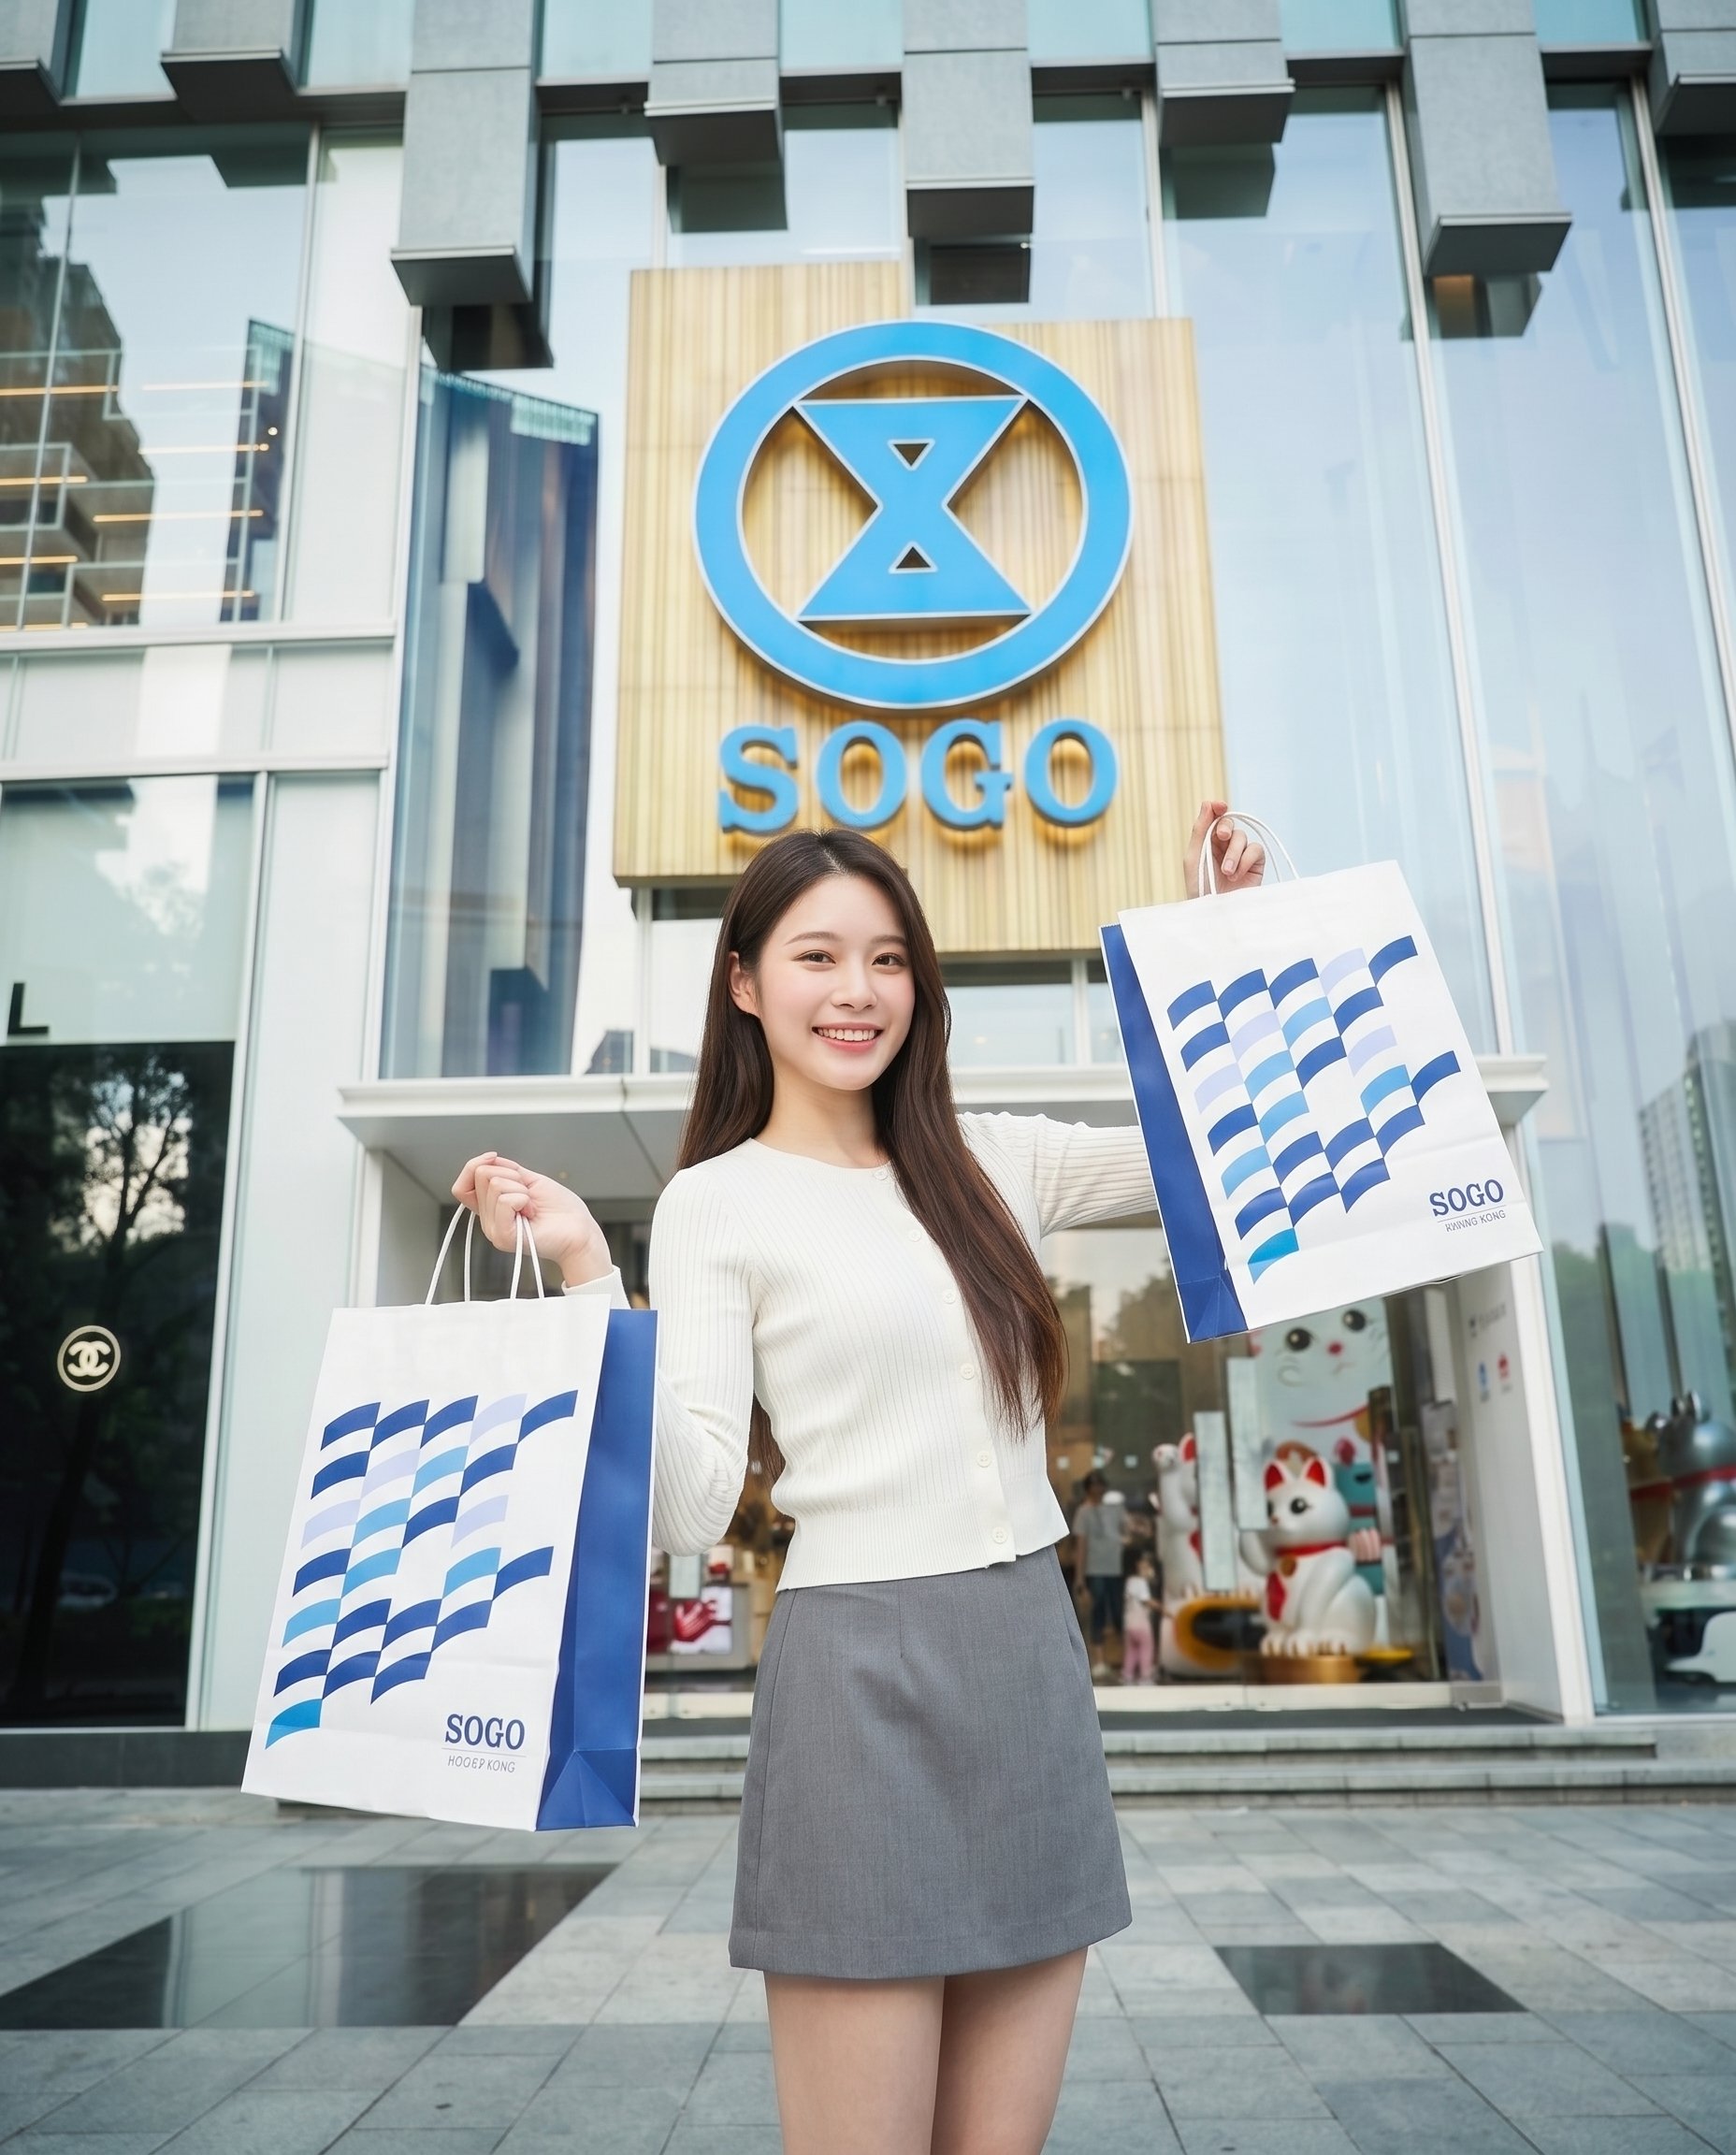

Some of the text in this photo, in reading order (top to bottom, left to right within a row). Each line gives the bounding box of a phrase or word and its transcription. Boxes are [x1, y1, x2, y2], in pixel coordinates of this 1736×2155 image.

[717, 717, 1120, 833] SOGO
[7, 982, 50, 1034] L
[1429, 1179, 1504, 1217] SOGO
[1480, 1209, 1506, 1224] KONG
[445, 1714, 526, 1750] SOGO
[486, 1759, 515, 1773] KONG
